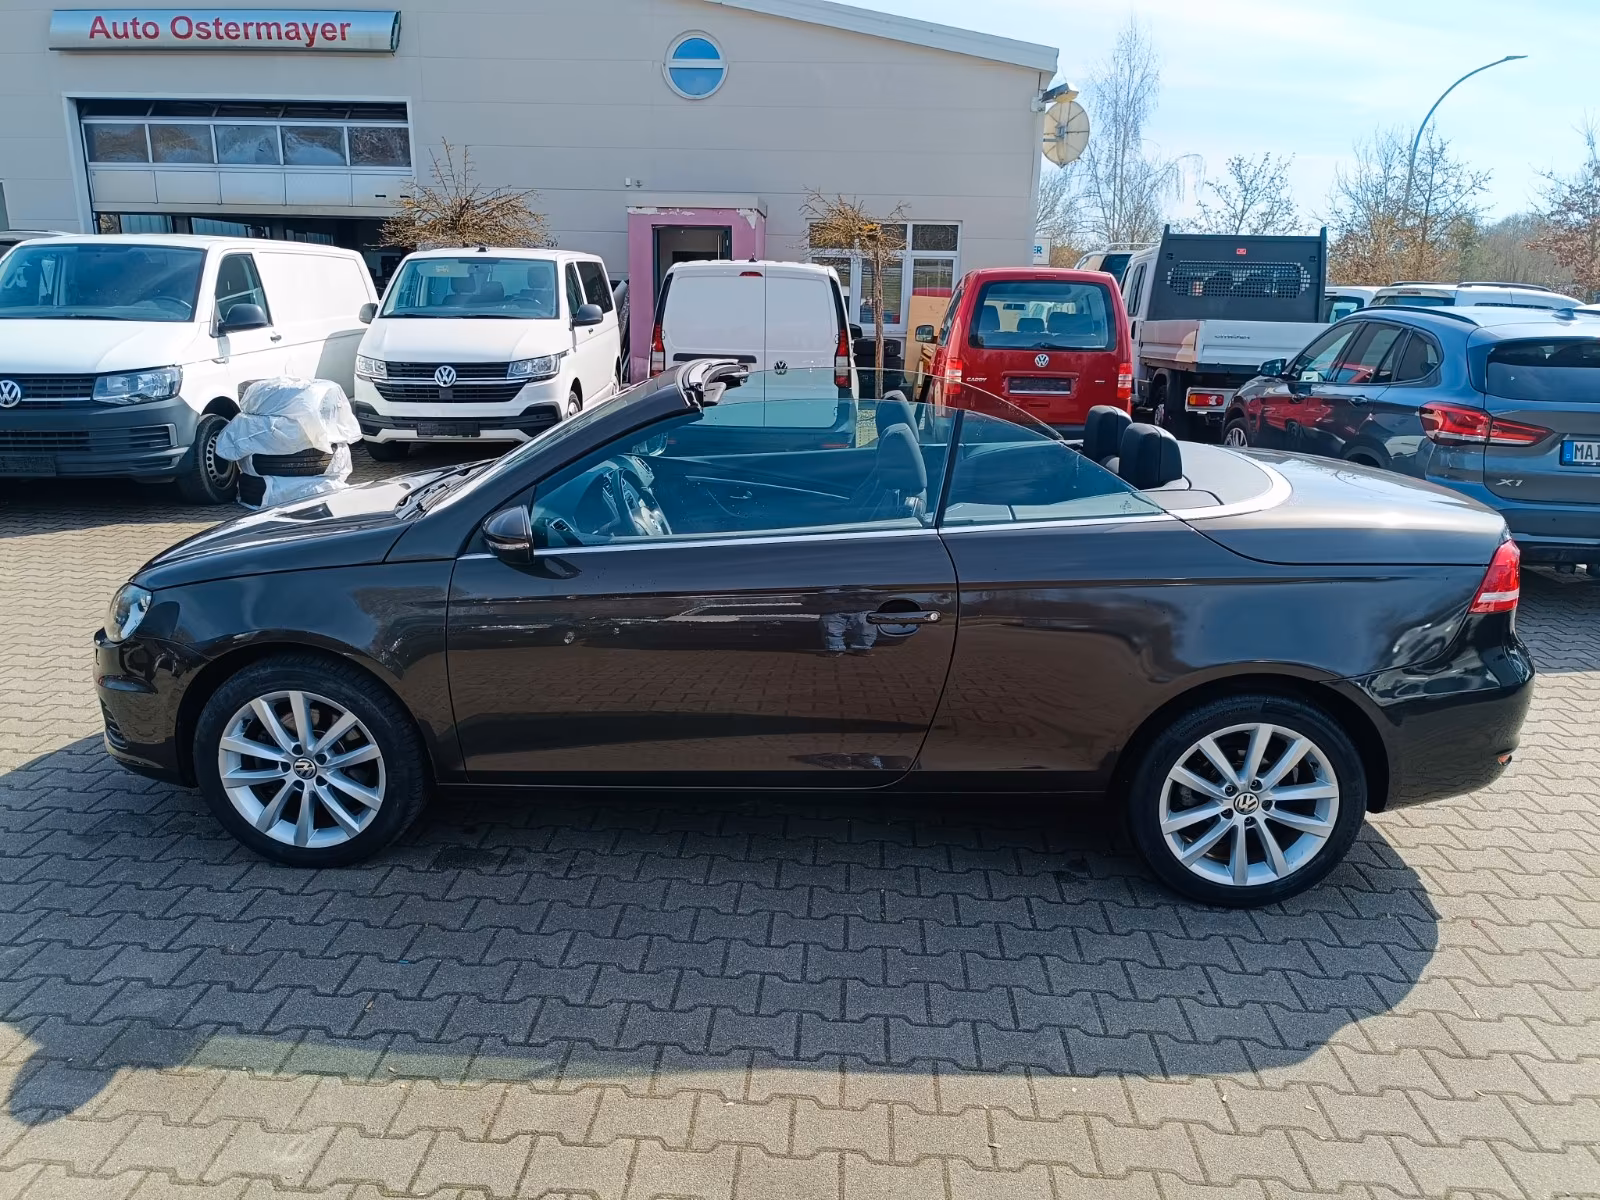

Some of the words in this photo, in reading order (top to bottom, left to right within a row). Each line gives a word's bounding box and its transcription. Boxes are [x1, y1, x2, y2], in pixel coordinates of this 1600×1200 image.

[89, 15, 160, 40] Auto
[170, 15, 352, 48] Ostermayer
[1495, 478, 1524, 487] X1
